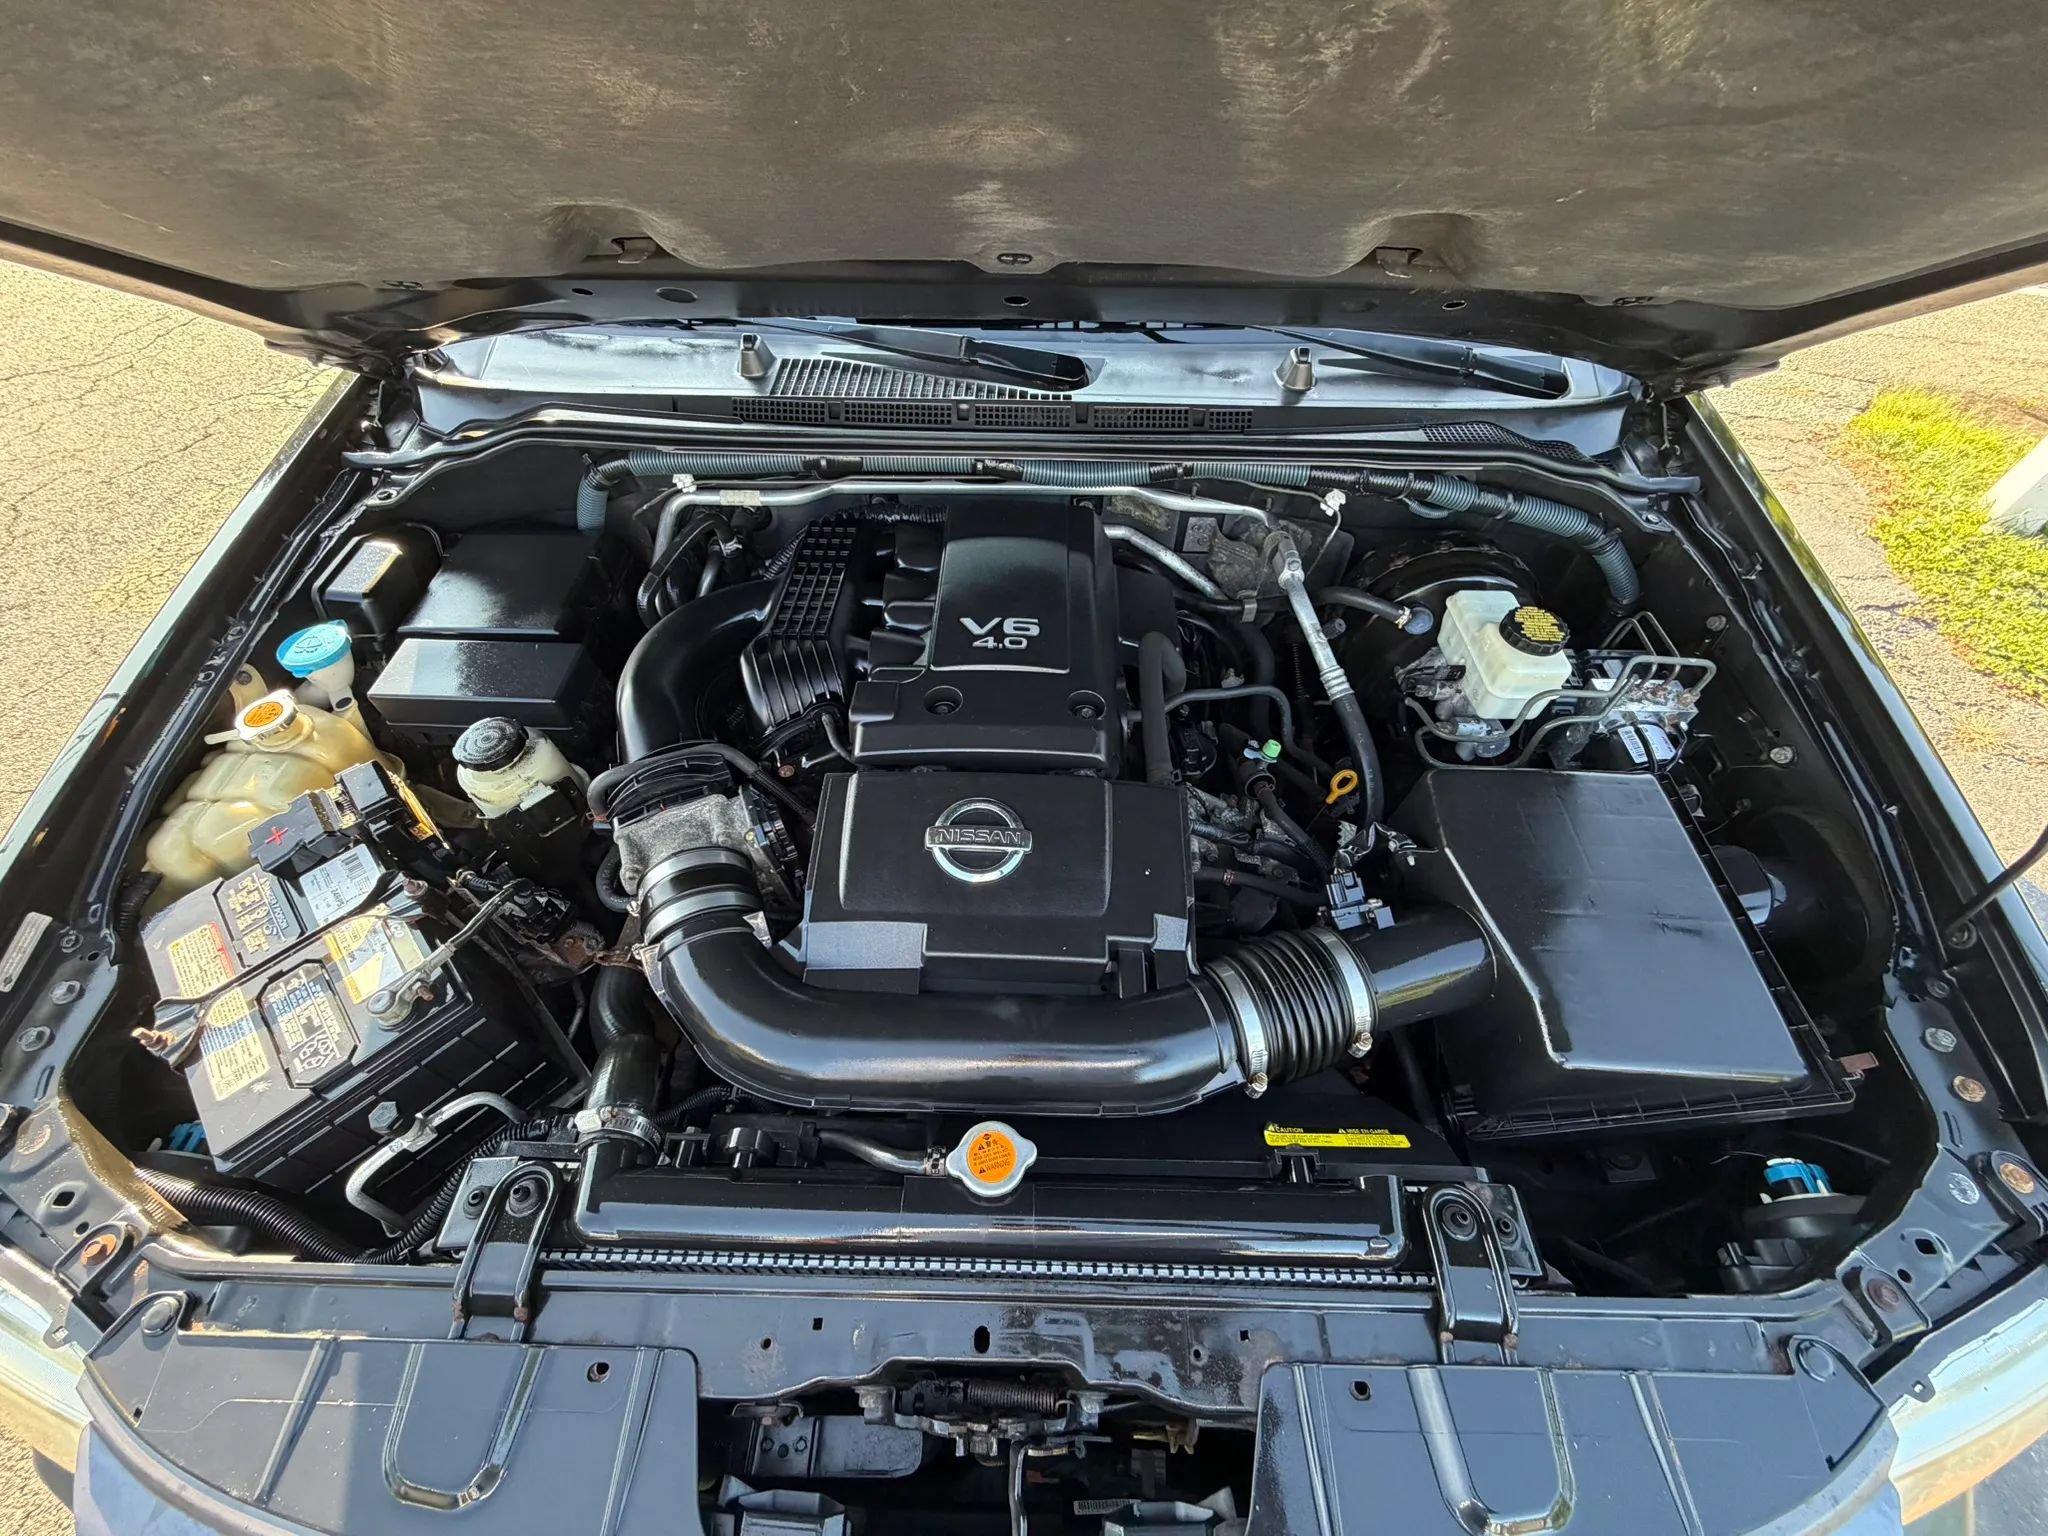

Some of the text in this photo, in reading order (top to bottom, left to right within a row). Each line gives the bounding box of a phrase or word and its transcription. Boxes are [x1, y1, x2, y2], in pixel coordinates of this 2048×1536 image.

[960, 617, 1040, 636] V6
[972, 636, 1028, 649] 4.0
[938, 828, 1021, 844] NISSAN
